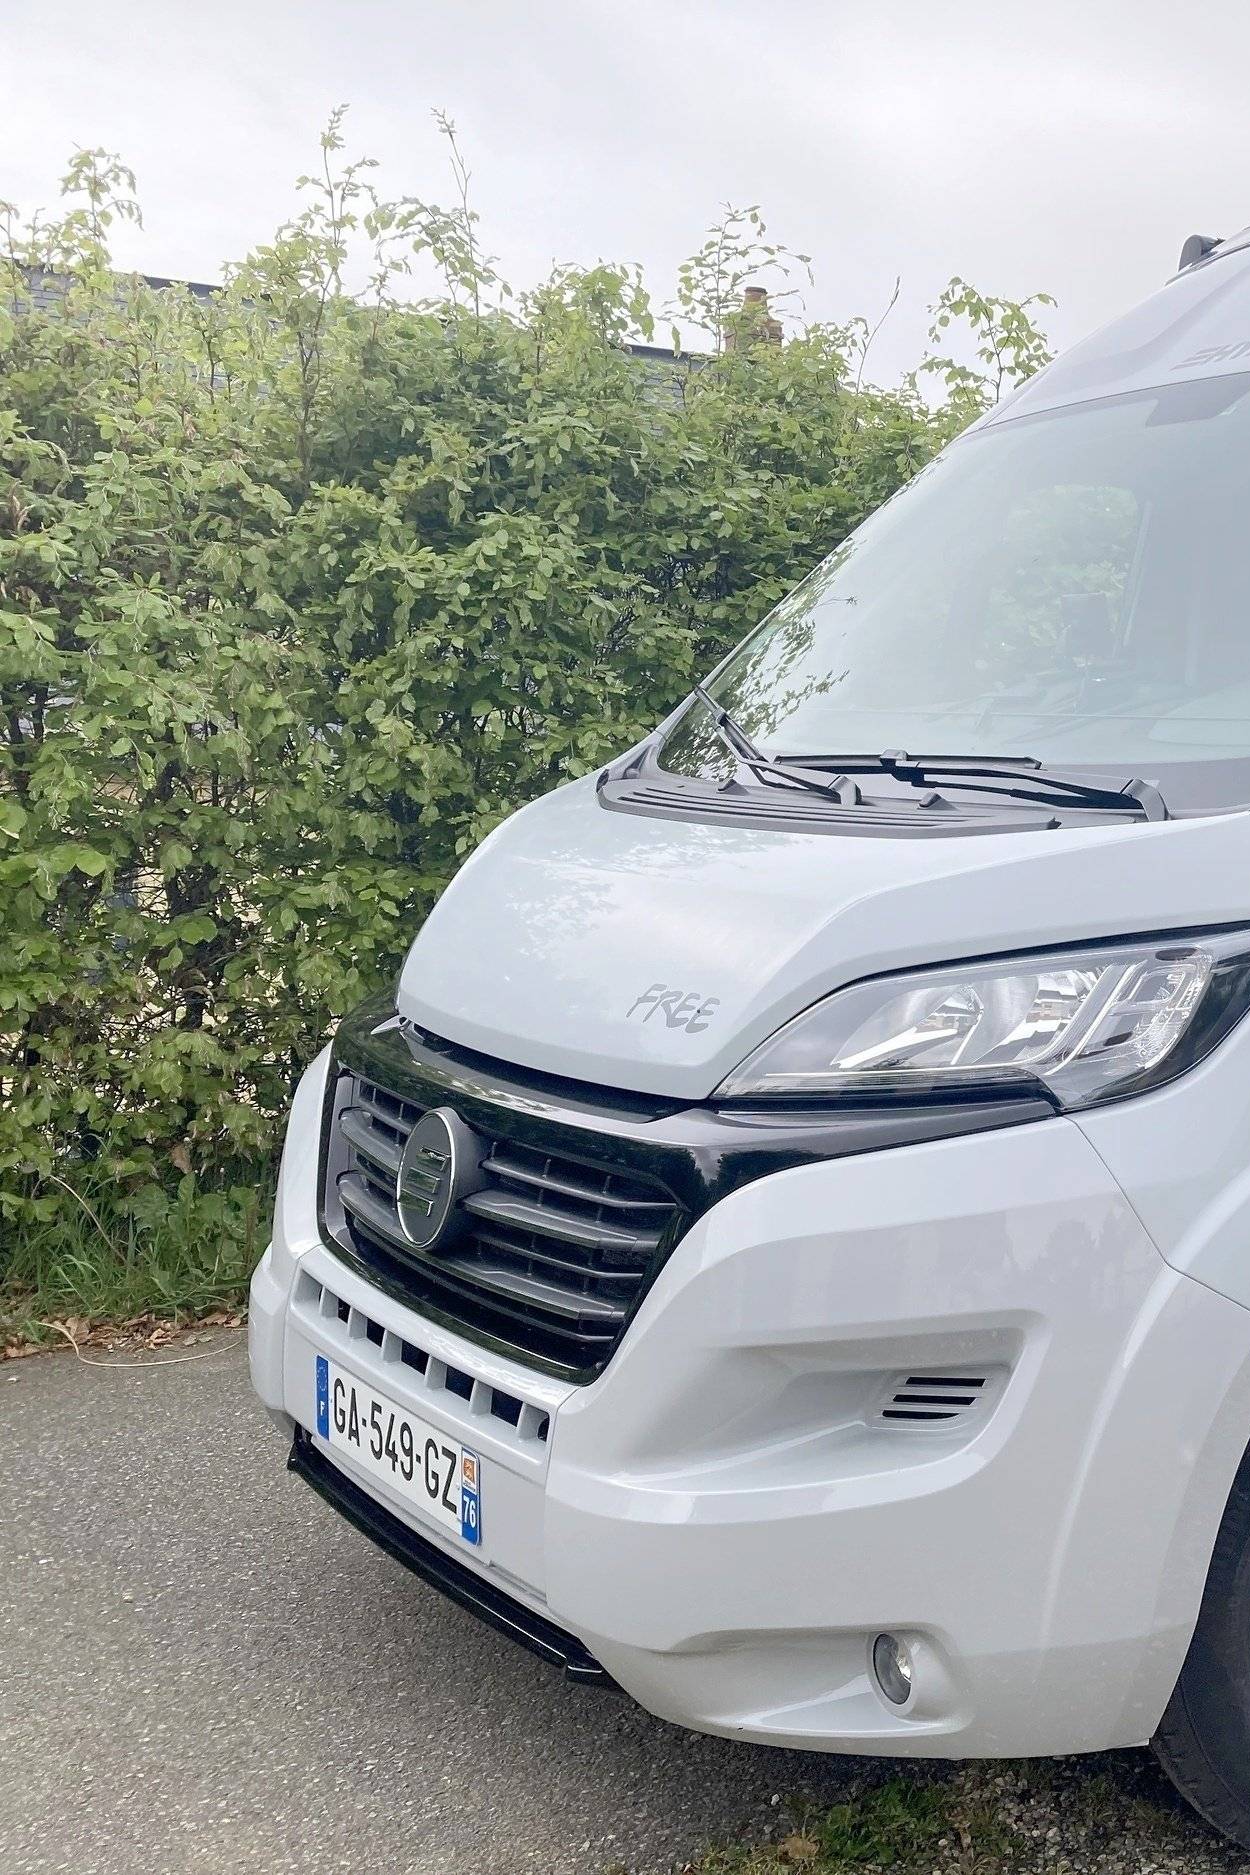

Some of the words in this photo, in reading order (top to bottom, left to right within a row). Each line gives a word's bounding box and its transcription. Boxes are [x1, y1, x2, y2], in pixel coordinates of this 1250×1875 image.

[625, 983, 721, 1034] FREE
[319, 1400, 326, 1416] F
[333, 1377, 458, 1515] GA-549-GZ
[463, 1496, 477, 1529] 76
